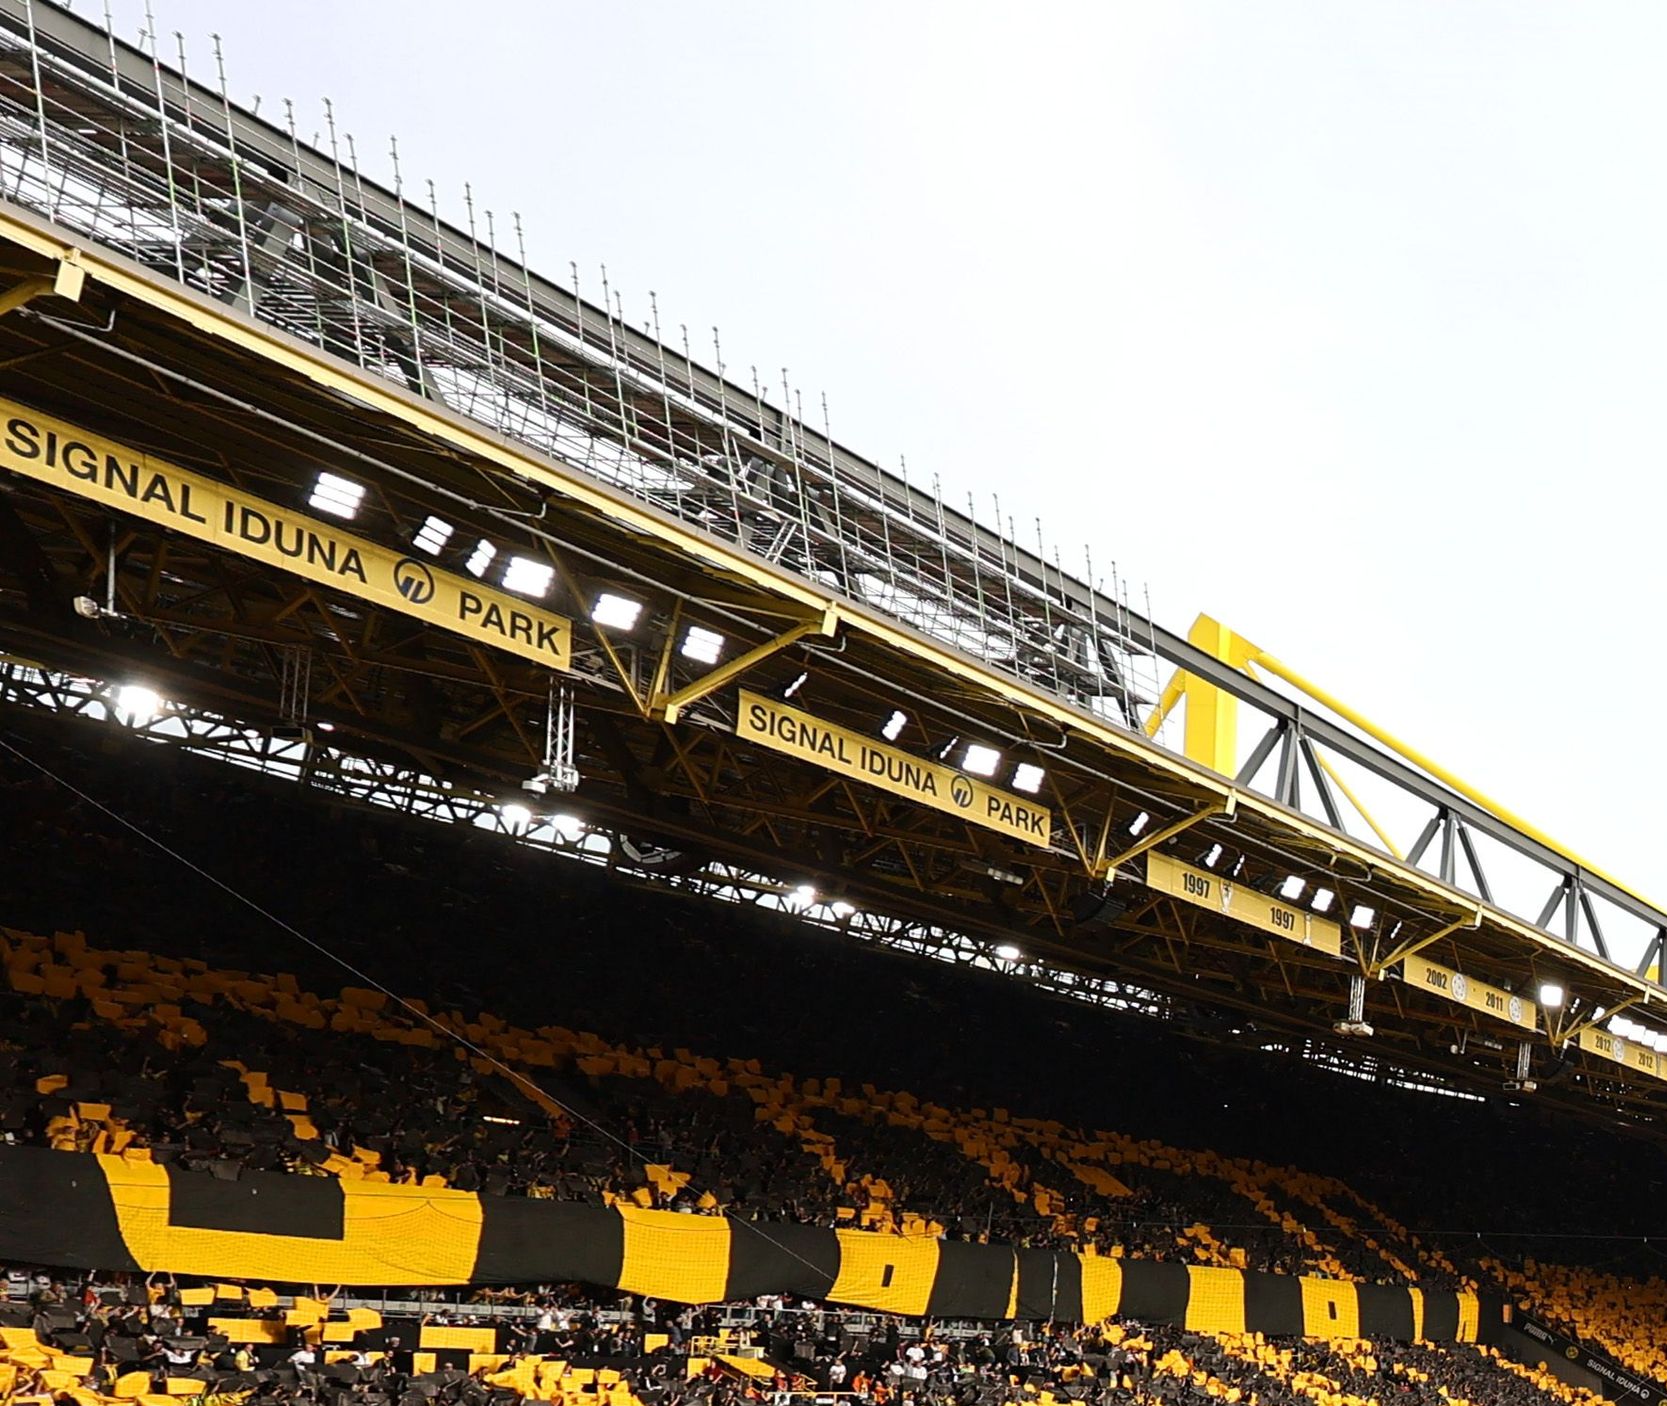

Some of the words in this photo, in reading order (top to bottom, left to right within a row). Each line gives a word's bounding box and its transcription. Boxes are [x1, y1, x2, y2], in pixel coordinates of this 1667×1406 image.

[3, 417, 207, 525] SIGNAL
[223, 506, 367, 585] IDUNA
[459, 592, 562, 656] PARK
[749, 705, 852, 765] SIGNAL
[860, 746, 938, 797] IDUNA
[986, 796, 1046, 838] PARK
[1182, 872, 1210, 899] 1997
[1270, 907, 1295, 932] 1997
[1426, 967, 1448, 990] 2002
[1485, 990, 1504, 1012] 2011
[1594, 1035, 1612, 1053] 2012
[1637, 1053, 1653, 1070] 2012
